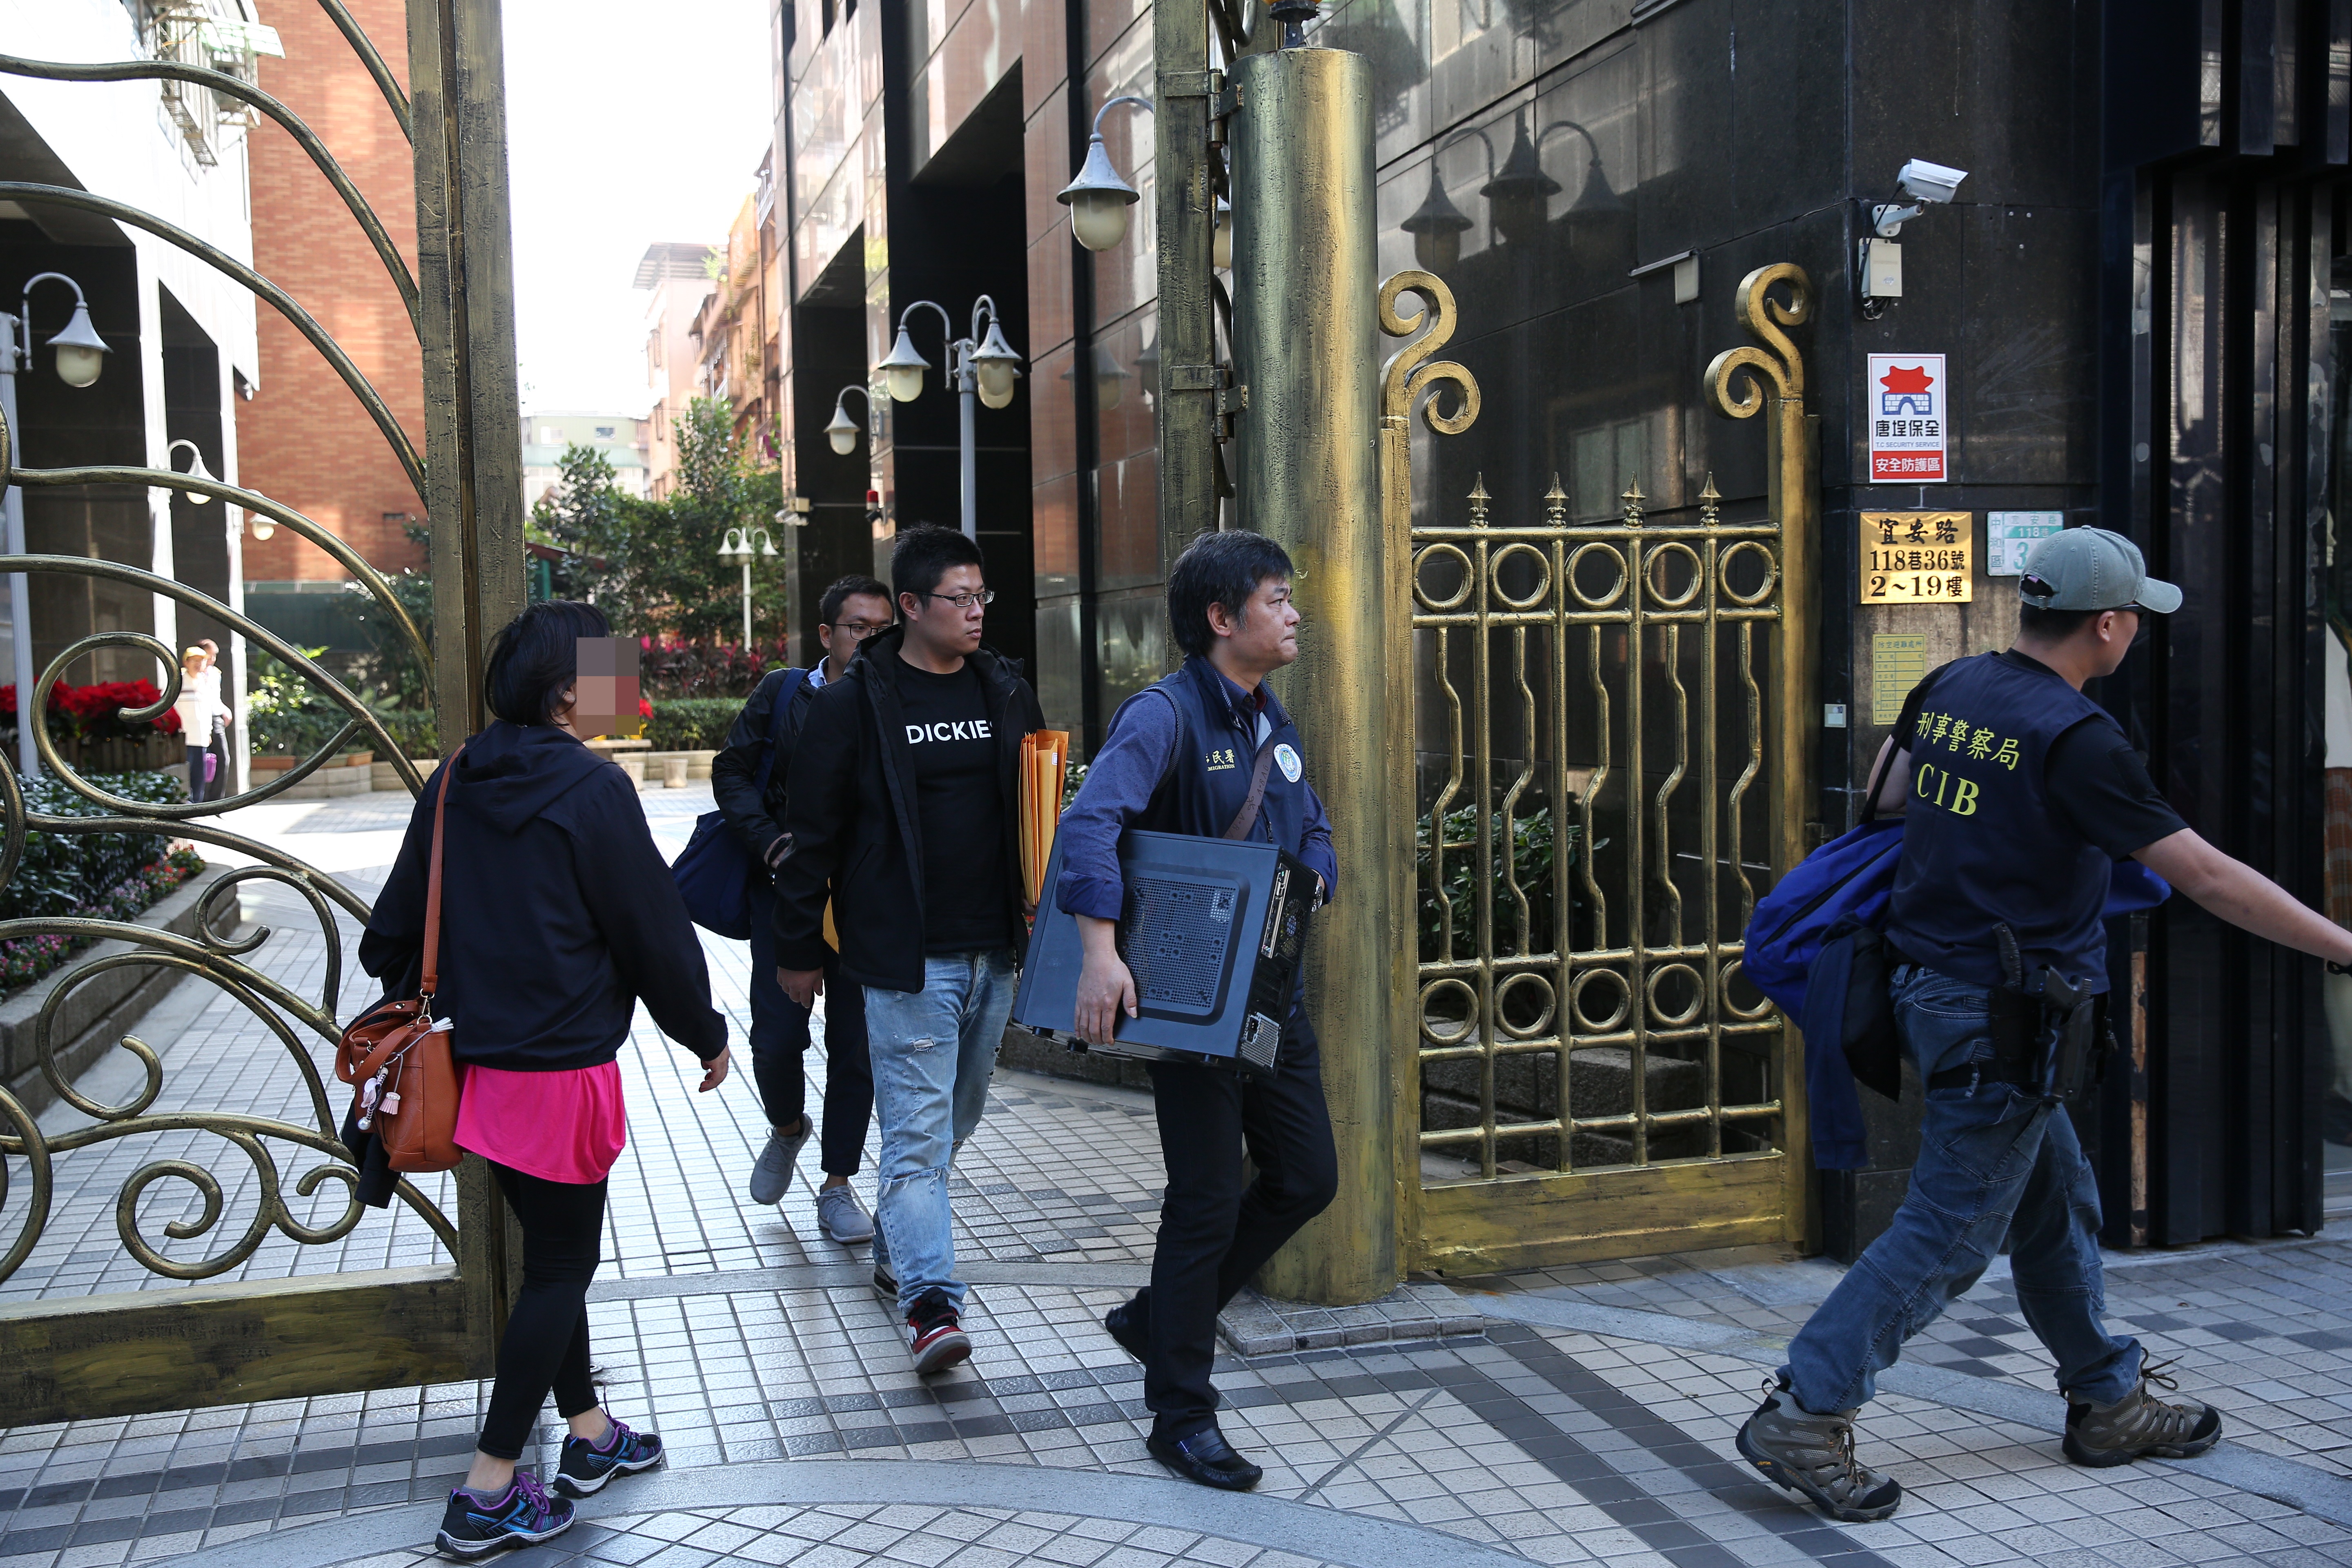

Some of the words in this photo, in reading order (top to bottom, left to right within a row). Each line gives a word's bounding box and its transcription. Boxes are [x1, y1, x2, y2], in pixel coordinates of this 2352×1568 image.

[1875, 420, 1939, 437] 唐埕保全
[1875, 457, 1941, 472] 安全防護區
[1879, 518, 1958, 545] 宜安路
[1870, 550, 1965, 571] 118巷36號
[905, 720, 993, 744] DICKIE
[1917, 712, 2020, 771] 刑事警察局
[1205, 749, 1235, 764] 民署
[1917, 763, 1980, 816] CIB
